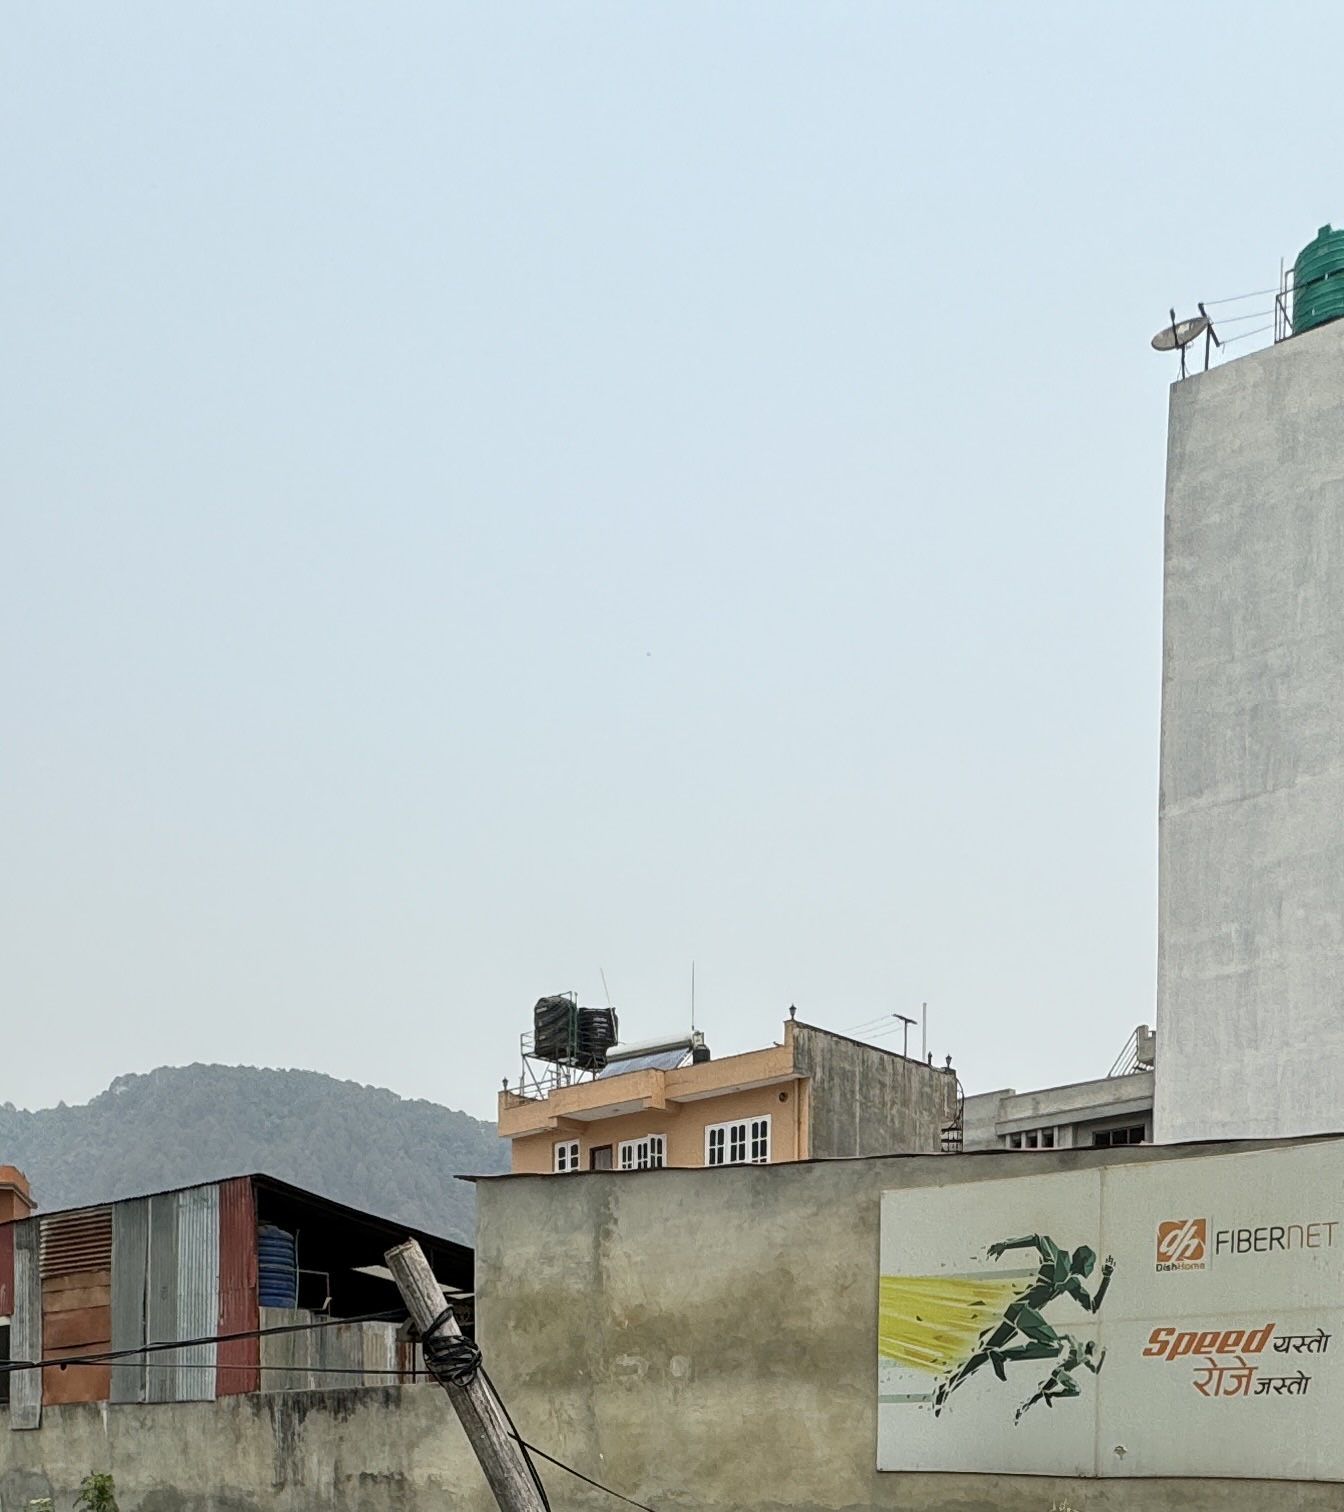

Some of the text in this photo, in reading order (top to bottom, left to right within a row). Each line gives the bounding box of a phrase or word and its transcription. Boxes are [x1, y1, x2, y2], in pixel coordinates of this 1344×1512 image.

[1215, 1221, 1339, 1255] FIBERNET
[1142, 1323, 1332, 1361] Speed यस्तो
[1193, 1355, 1312, 1397] रोजे जस्तो
